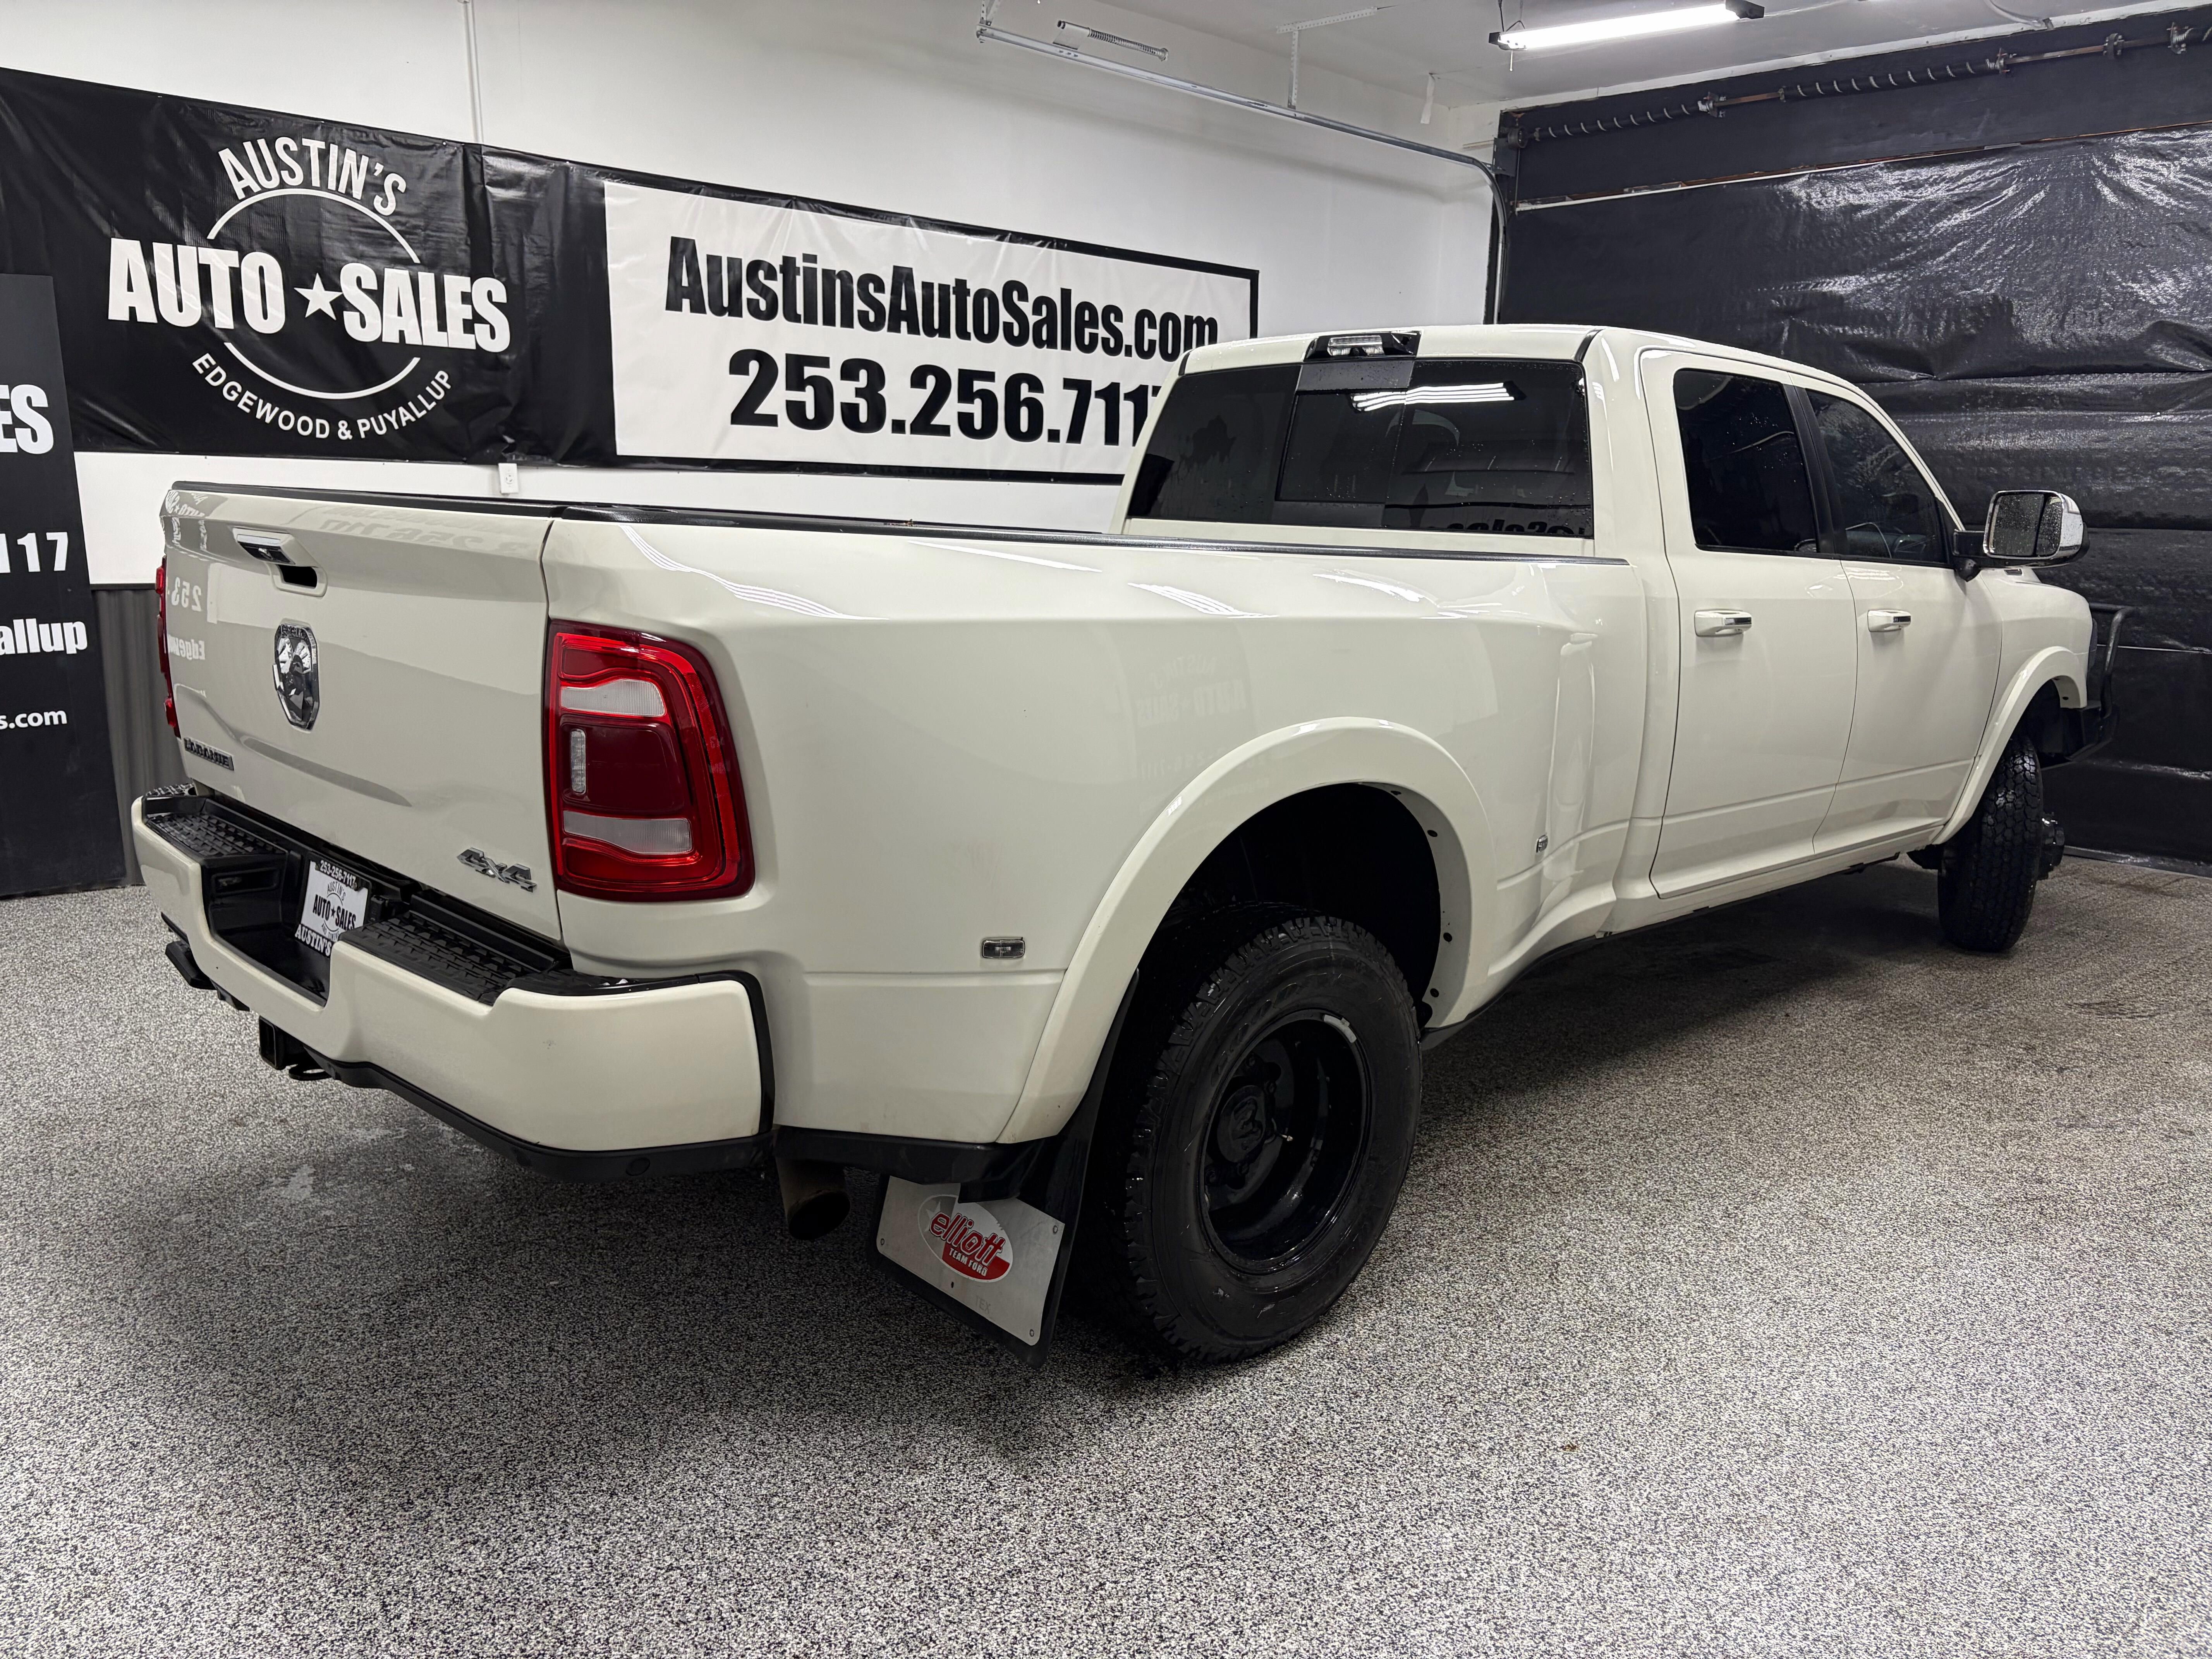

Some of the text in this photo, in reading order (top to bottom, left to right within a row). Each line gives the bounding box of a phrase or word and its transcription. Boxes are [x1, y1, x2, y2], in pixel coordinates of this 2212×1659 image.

[218, 137, 406, 216] AUSTIN'S
[107, 238, 511, 352] AUTO SALES
[665, 237, 1218, 362] AustinsAutoSales.com
[192, 353, 452, 440] EDGEWOOD & PUYALLUP
[729, 348, 1162, 447] 253.256.711
[320, 860, 357, 887] 253-256-7117
[327, 880, 346, 901] AUSTIN'S
[313, 894, 356, 931] AUTO SALES
[295, 924, 332, 957] AUSTIN'S
[929, 1211, 1006, 1266] elliott
[949, 1248, 988, 1276] TEAM FORD
